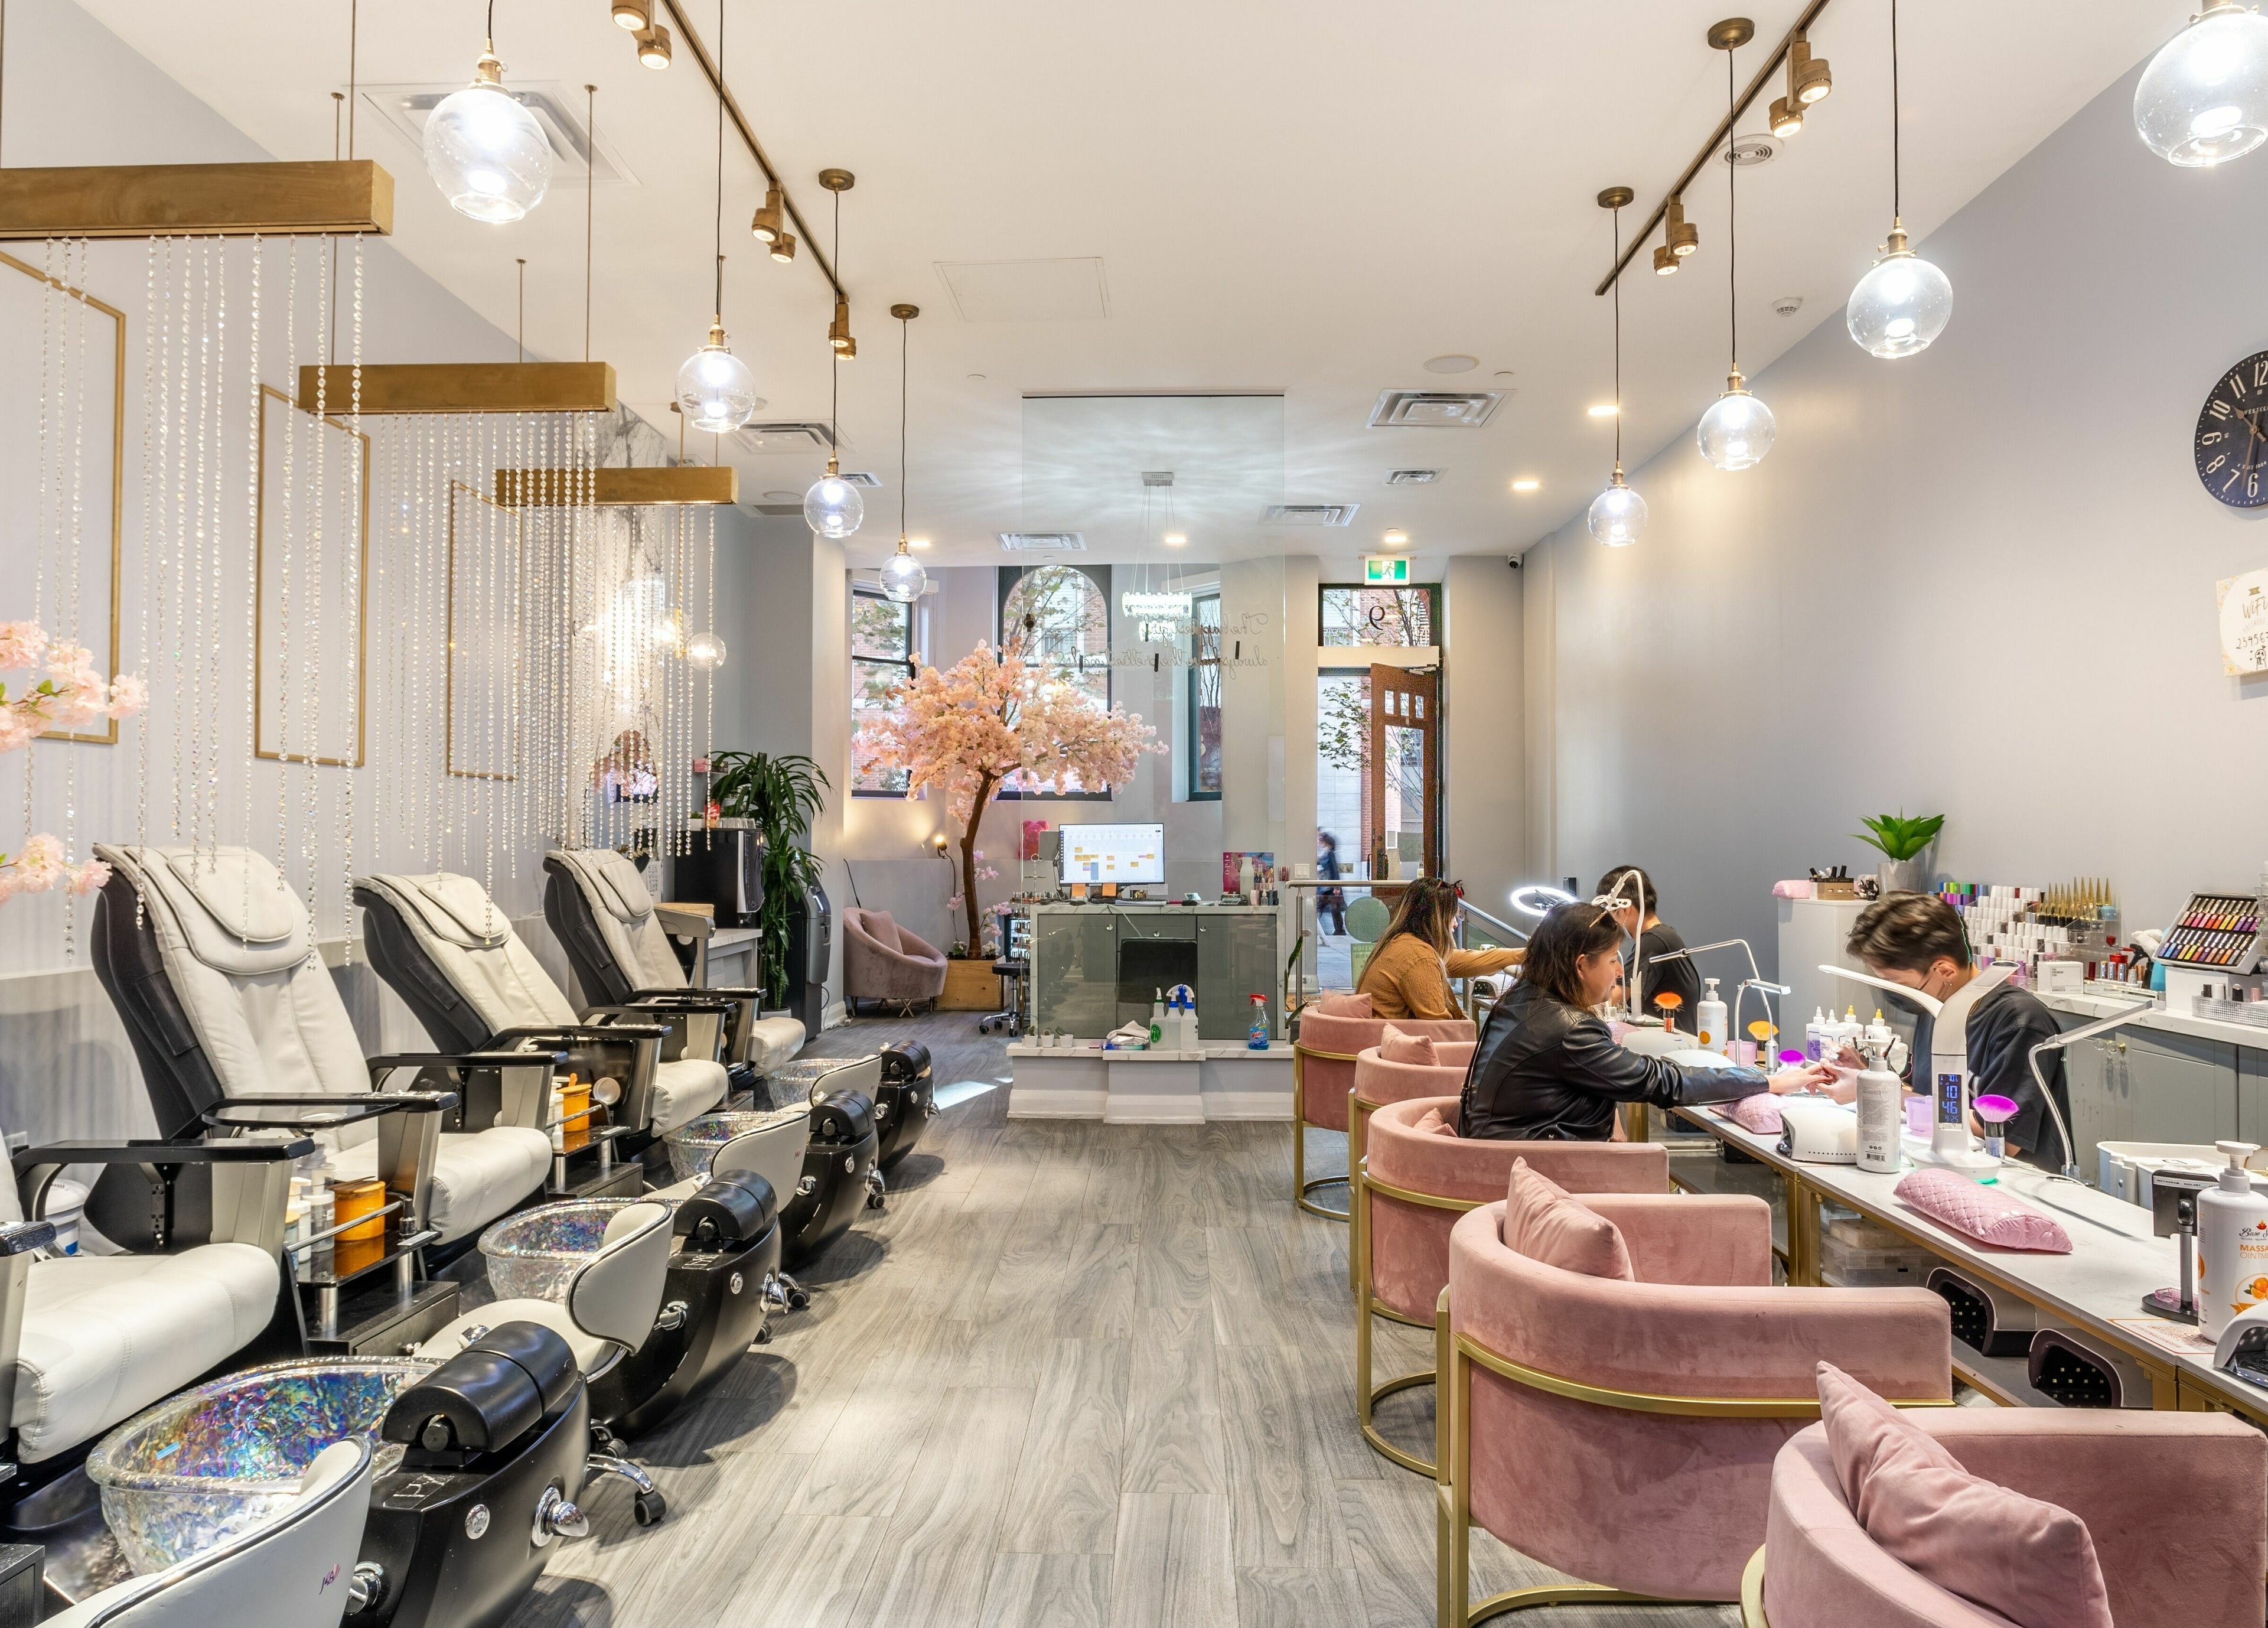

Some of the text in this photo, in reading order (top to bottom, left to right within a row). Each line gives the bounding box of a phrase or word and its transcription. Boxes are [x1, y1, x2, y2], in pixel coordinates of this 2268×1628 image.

[2254, 360, 2268, 388] 12
[2229, 374, 2246, 399] 11
[2209, 399, 2231, 421] 10
[2202, 431, 2222, 445] 9
[2206, 455, 2225, 474] 8
[2222, 468, 2241, 493] 7
[2247, 473, 2259, 498] 6
[2243, 595, 2268, 619] WiFi
[1946, 1085, 1958, 1099] 10
[1941, 1100, 1958, 1114] 46
[2239, 1227, 2260, 1238] Bare
